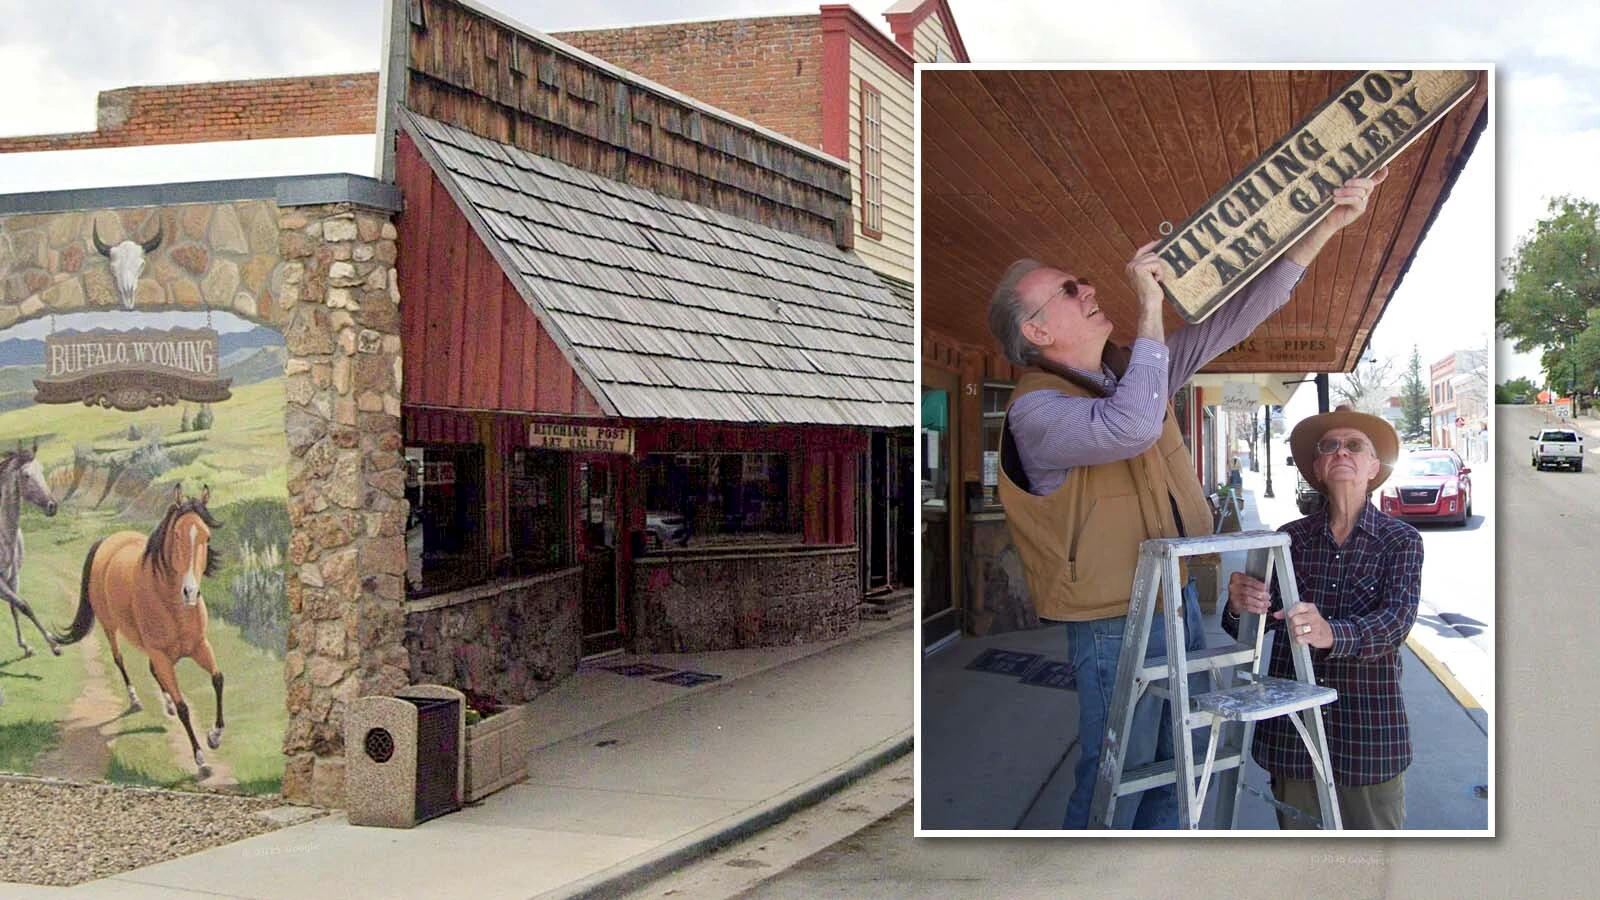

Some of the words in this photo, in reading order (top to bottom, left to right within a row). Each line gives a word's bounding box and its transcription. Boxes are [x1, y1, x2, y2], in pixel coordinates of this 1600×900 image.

[1211, 219, 1276, 285] ART
[1290, 87, 1427, 214] GALLERY
[1159, 129, 1327, 278] HITCHING
[51, 343, 129, 376] BUFFALO,
[132, 340, 213, 374] WYOMING
[1284, 340, 1326, 351] PIPES
[534, 423, 588, 438] HITCHING
[597, 428, 625, 440] POST
[543, 437, 562, 449] ART
[569, 438, 616, 452] GALLERY
